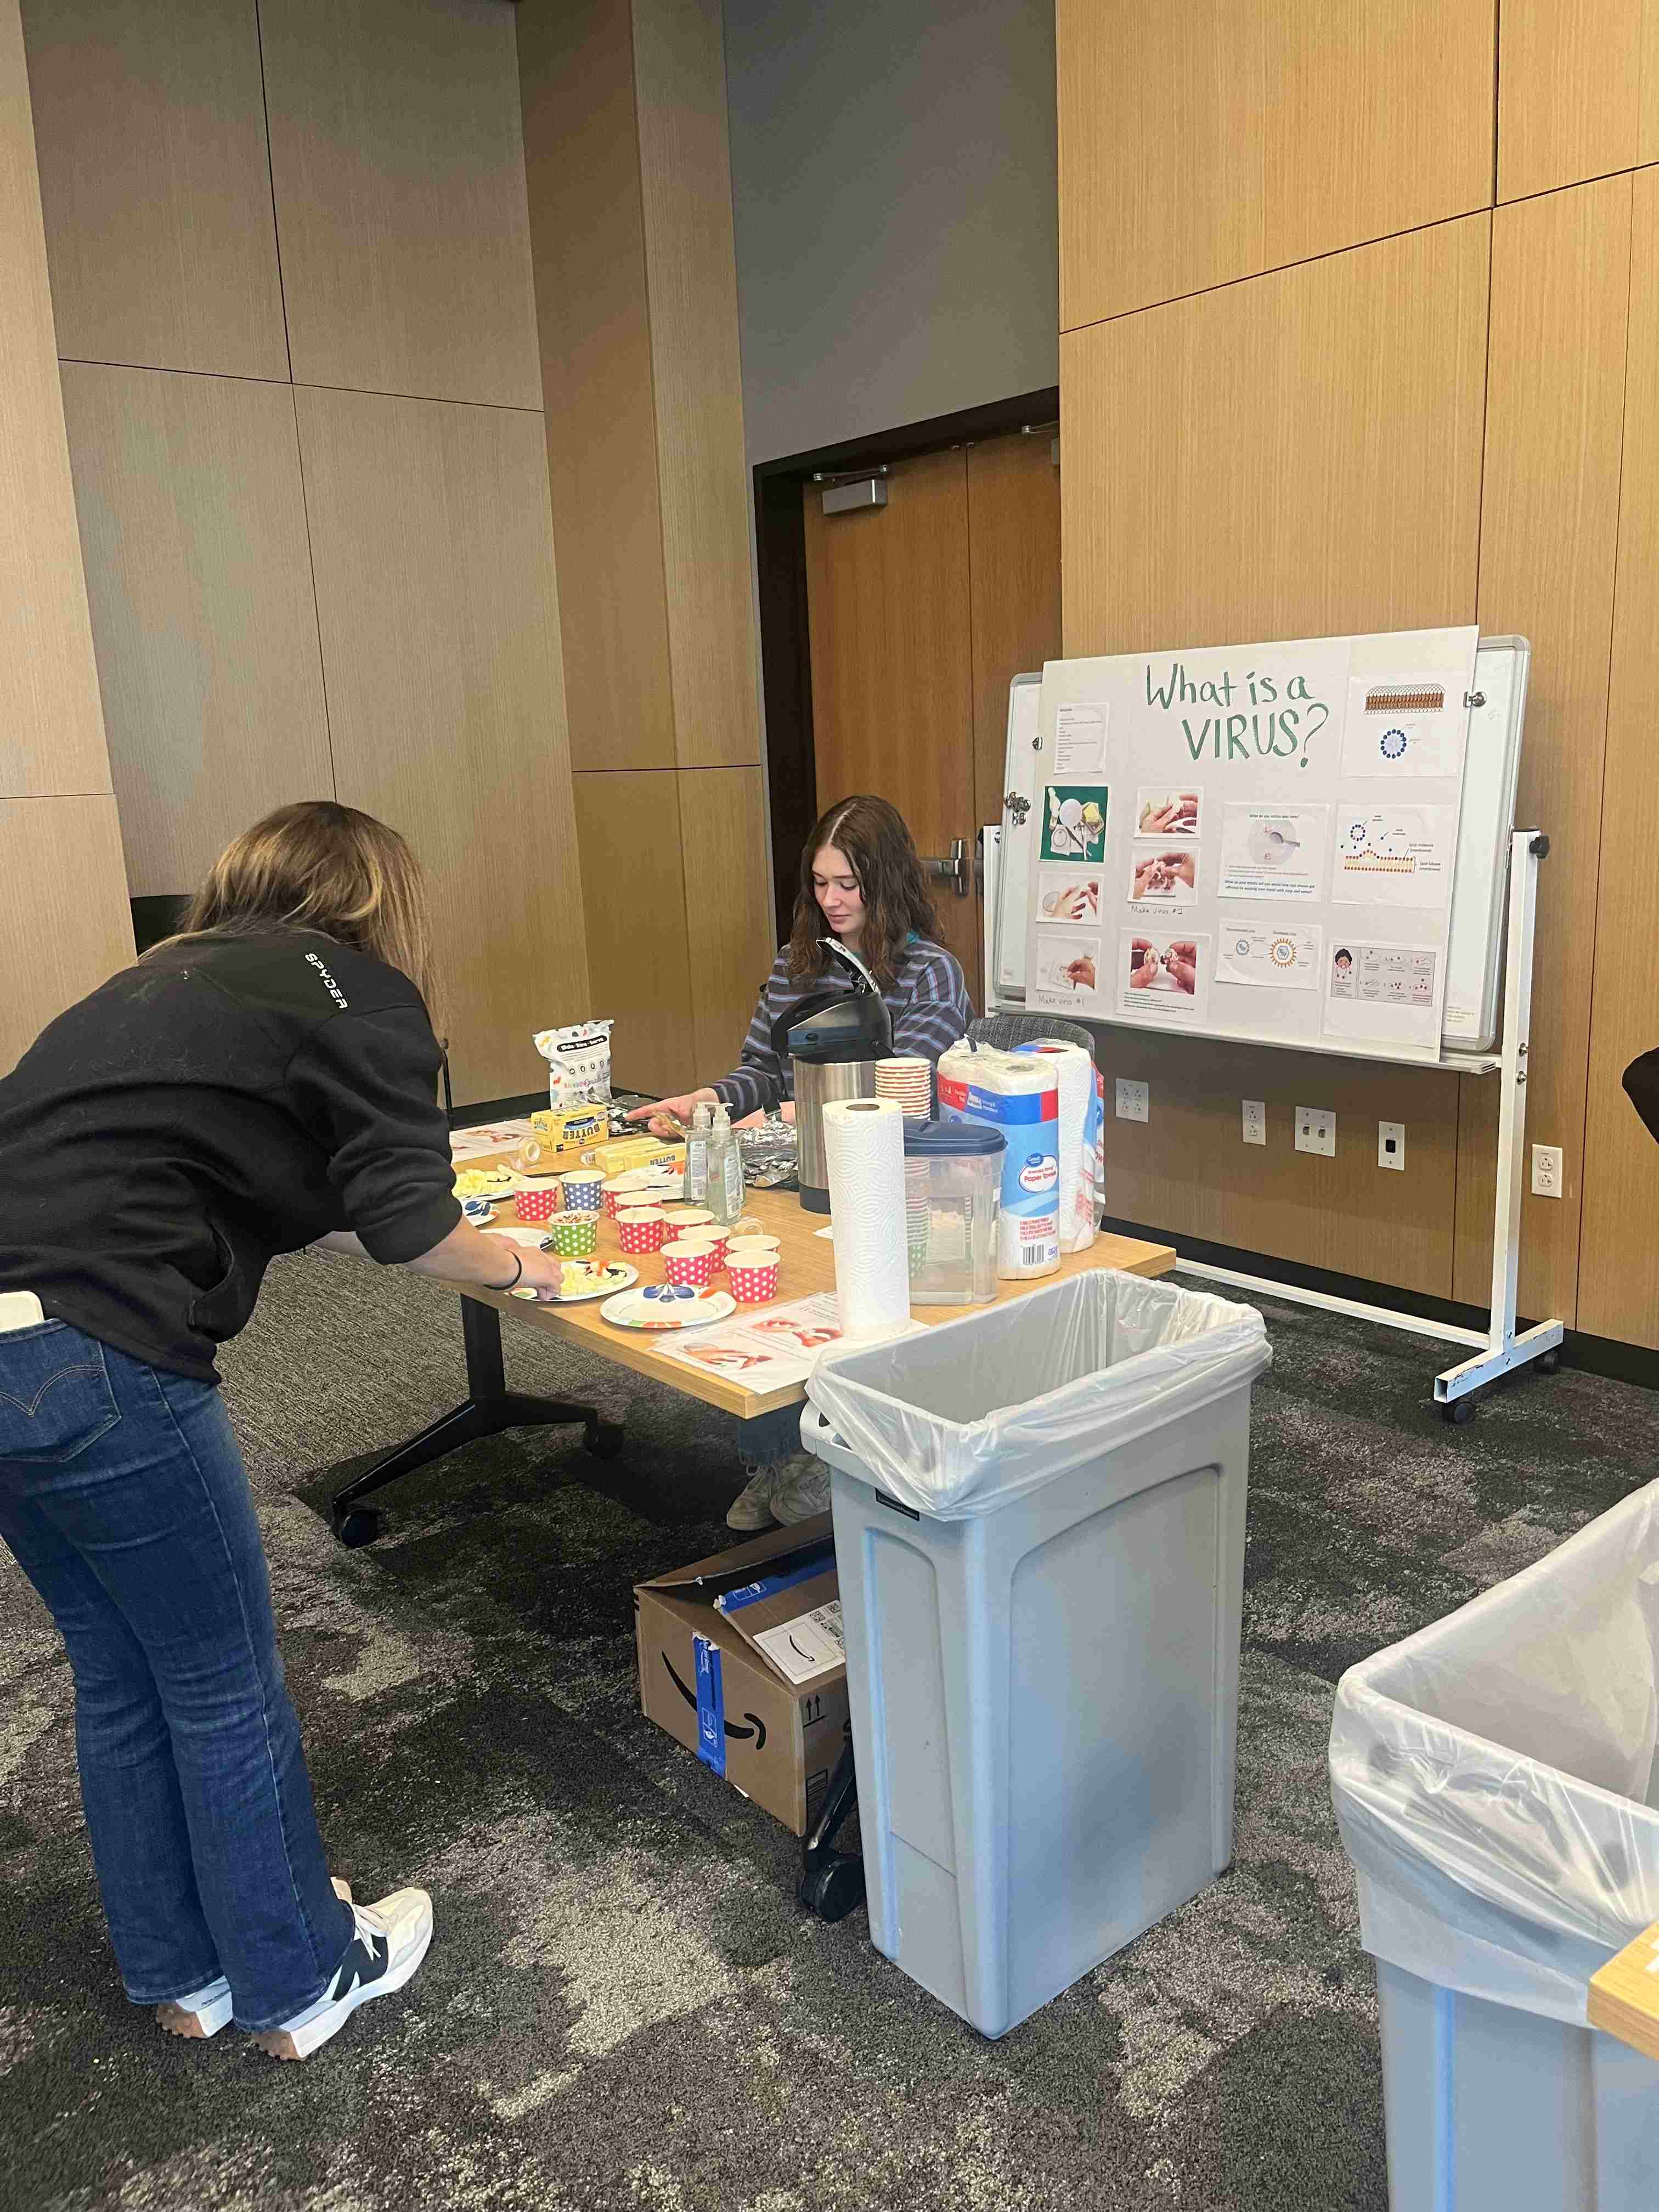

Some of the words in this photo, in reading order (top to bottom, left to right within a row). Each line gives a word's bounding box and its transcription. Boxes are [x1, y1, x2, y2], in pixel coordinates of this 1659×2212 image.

[1147, 663, 1238, 709] What
[1245, 671, 1278, 706] is
[1286, 675, 1316, 700] a
[1181, 703, 1329, 768] VIRUS?
[1131, 905, 1150, 914] Make
[304, 953, 348, 1009] SPYDER
[562, 1123, 601, 1140] BUTTER
[650, 1154, 676, 1166] BUTTER
[1024, 1175, 1042, 1183] Paper
